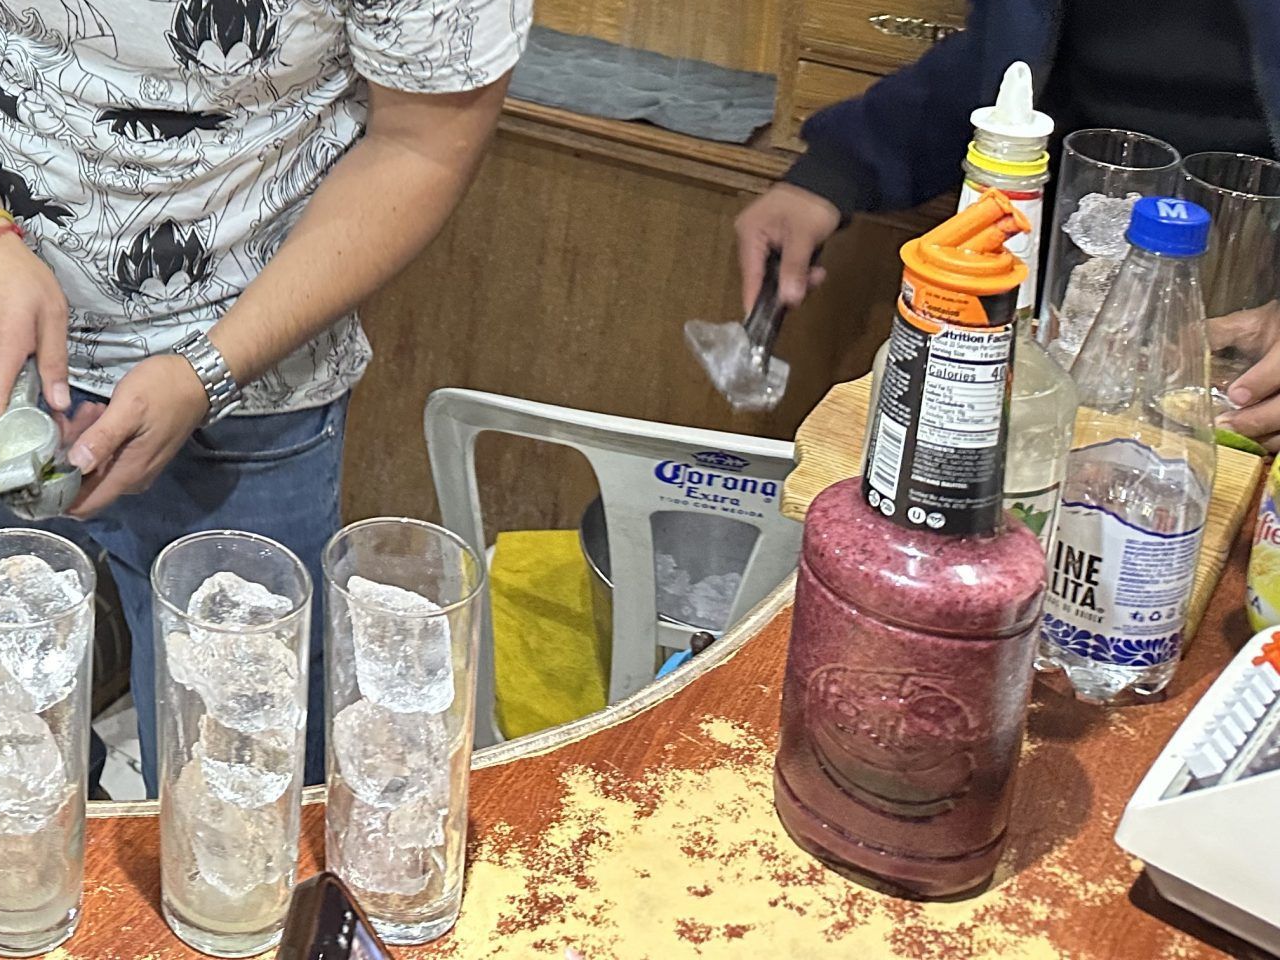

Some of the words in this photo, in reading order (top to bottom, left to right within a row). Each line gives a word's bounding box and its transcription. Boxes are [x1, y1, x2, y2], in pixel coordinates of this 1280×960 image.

[1156, 200, 1189, 219] M
[940, 330, 984, 344] trition
[928, 364, 977, 382] Calories
[654, 460, 778, 498] Corona
[685, 486, 741, 507] Extra
[1054, 540, 1103, 586] INE
[1051, 570, 1097, 611] LITA
